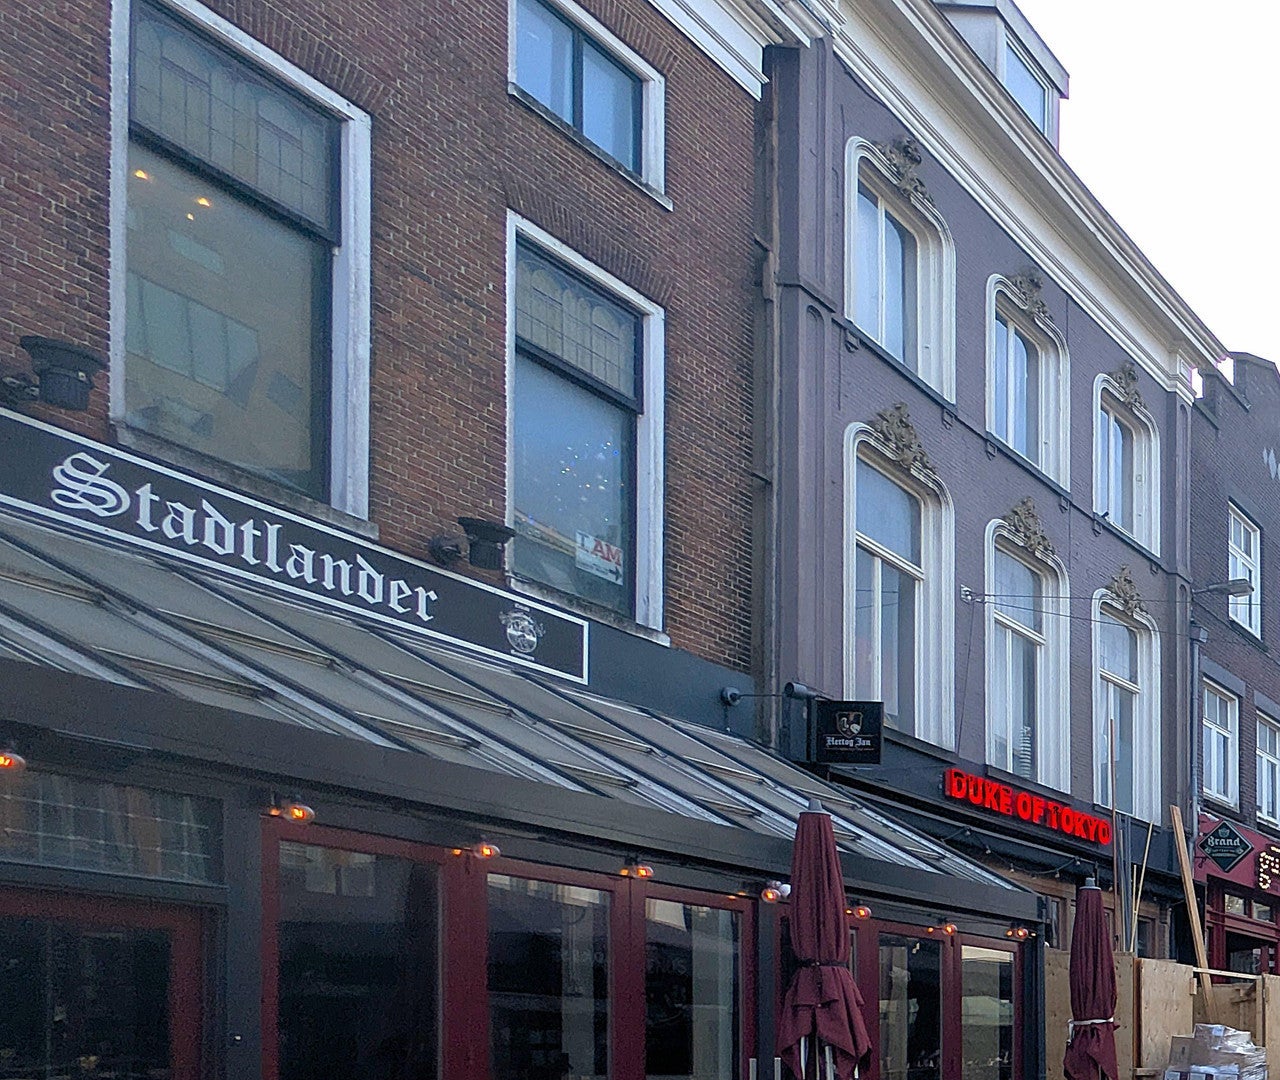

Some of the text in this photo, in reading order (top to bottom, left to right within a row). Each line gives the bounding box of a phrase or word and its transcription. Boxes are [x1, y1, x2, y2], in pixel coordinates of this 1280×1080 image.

[51, 452, 438, 622] Stadtlander
[591, 540, 622, 567] AM
[826, 736, 871, 748] Hertog Jan
[945, 768, 1112, 846] DUKE OF TOKYO
[1207, 835, 1241, 847] Brand
